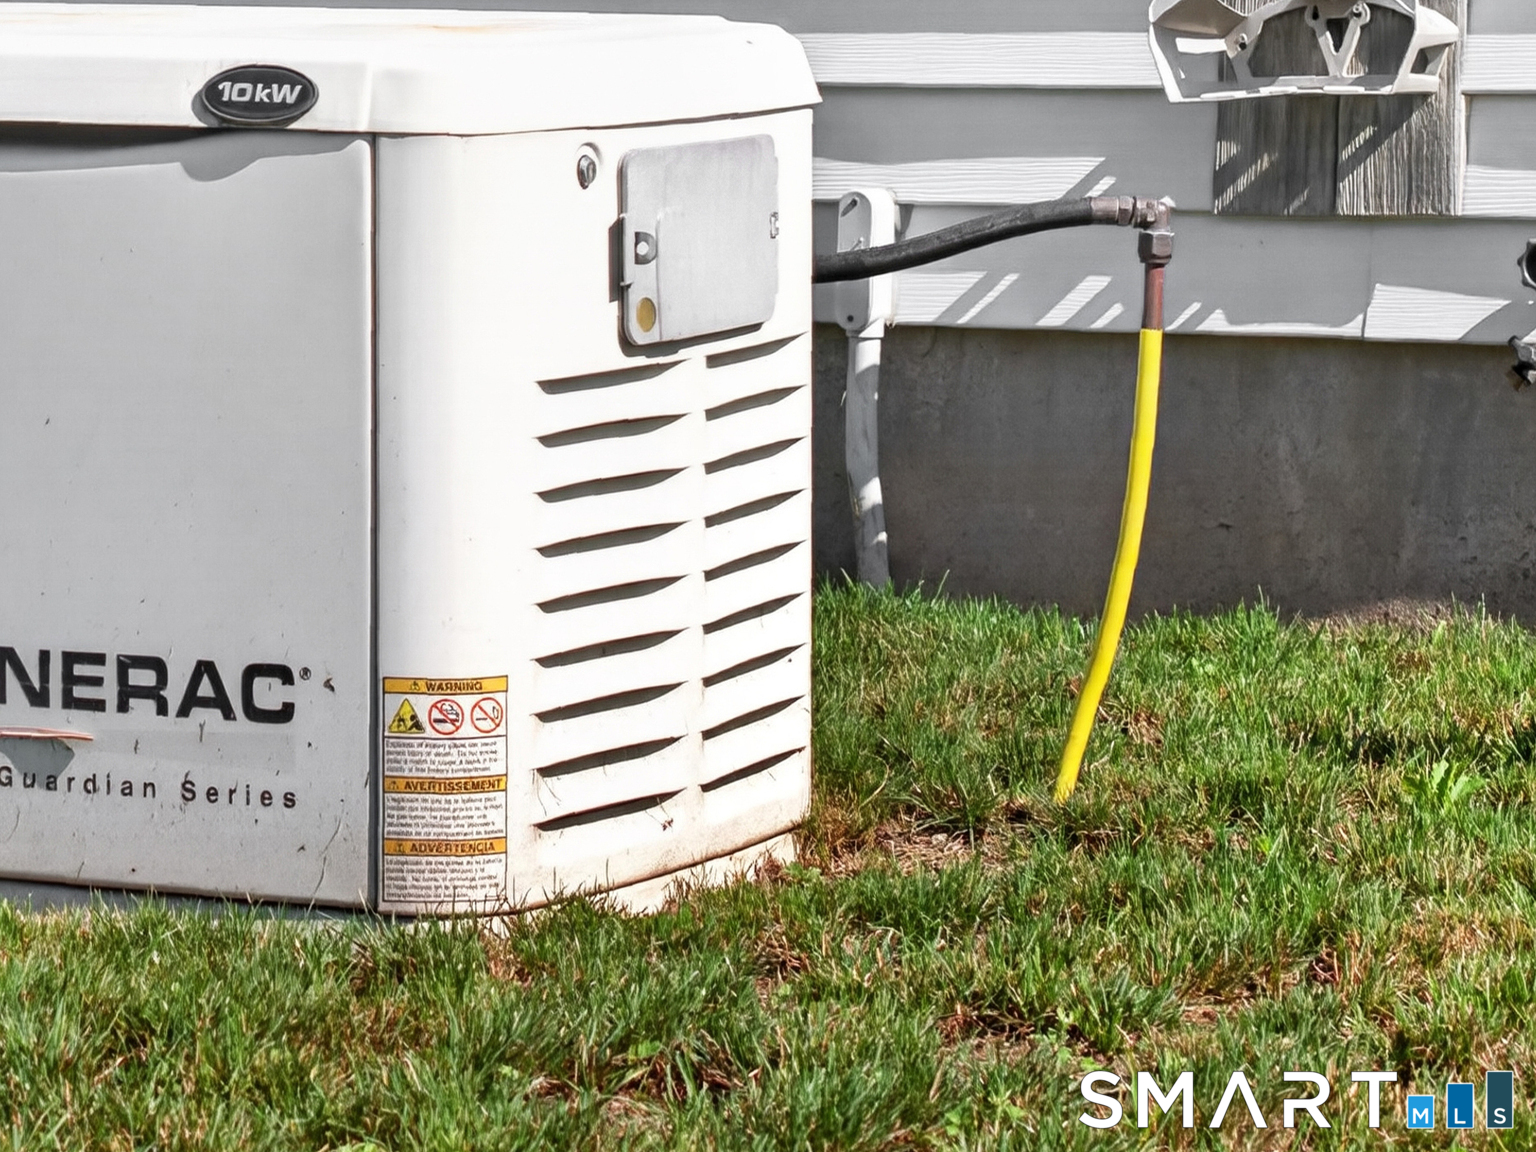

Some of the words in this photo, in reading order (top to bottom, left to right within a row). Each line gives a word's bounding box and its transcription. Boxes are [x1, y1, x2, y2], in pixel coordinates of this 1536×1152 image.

[425, 681, 483, 692] WARNING
[404, 778, 503, 792] AVERTISSEMENT
[180, 778, 297, 808] Series
[409, 841, 496, 854] ADVERTENCIA
